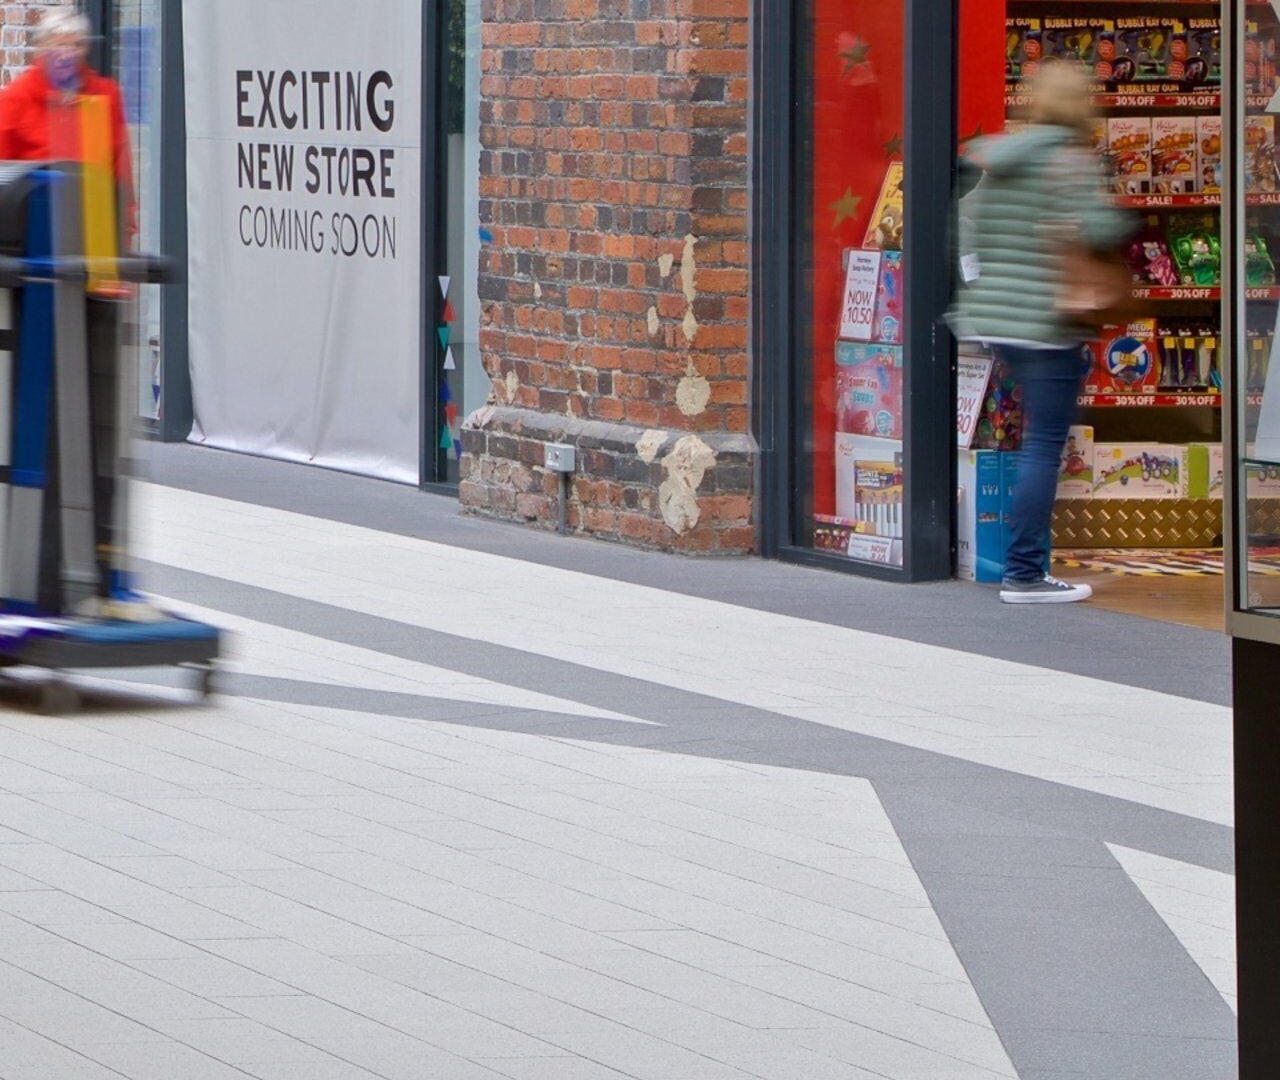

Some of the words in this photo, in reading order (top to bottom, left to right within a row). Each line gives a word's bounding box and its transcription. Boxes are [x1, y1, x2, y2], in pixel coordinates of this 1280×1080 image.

[236, 70, 395, 133] EXCITING
[238, 142, 294, 191] NEW
[305, 146, 396, 198] STORE
[1146, 195, 1173, 205] SALE!
[1203, 195, 1221, 204] SAL
[239, 204, 324, 254] COMING
[331, 212, 396, 259] SOON
[847, 290, 872, 307] NOW
[958, 397, 976, 413] OW
